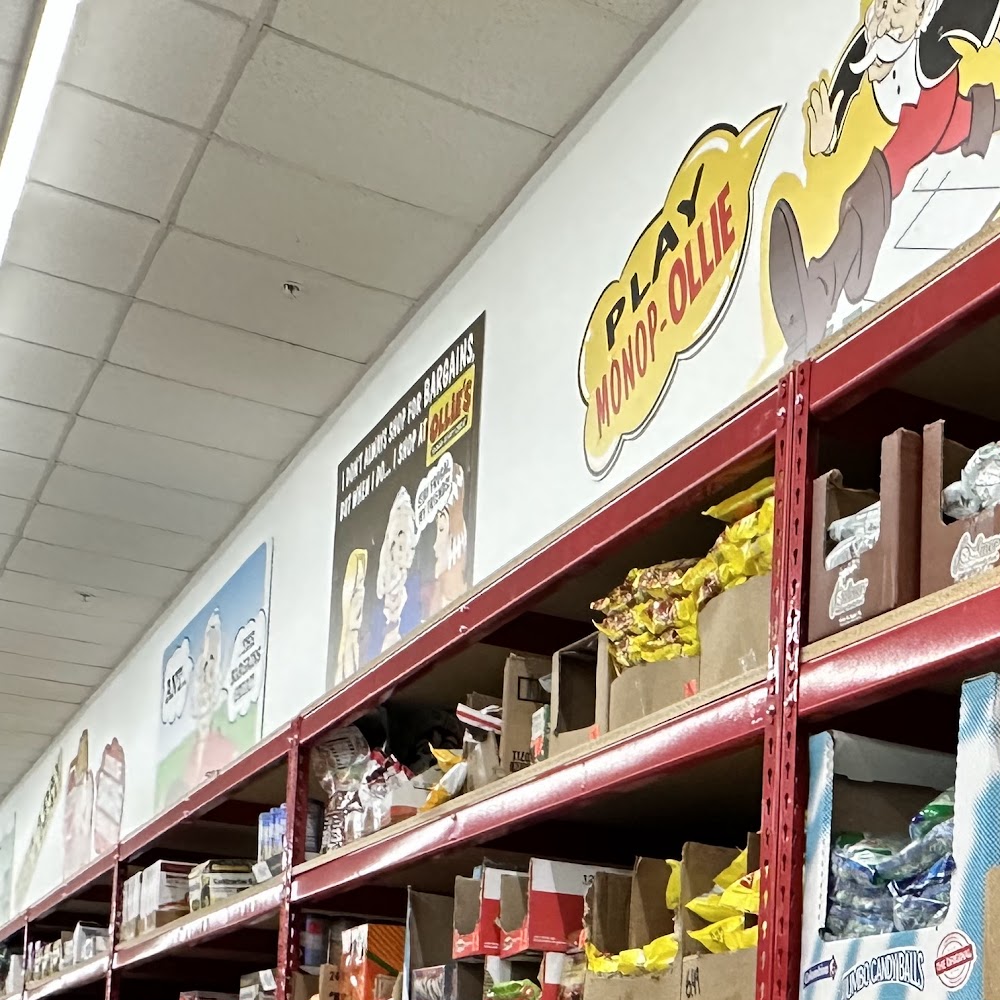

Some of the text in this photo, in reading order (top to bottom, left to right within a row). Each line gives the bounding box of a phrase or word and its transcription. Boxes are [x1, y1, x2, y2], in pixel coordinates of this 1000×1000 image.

[595, 181, 736, 438] MONOP-OLLIE
[606, 163, 704, 350] PLAY
[429, 377, 473, 444] OLLIE'S
[871, 949, 901, 985] CANDY
[900, 949, 925, 992] BALLS
